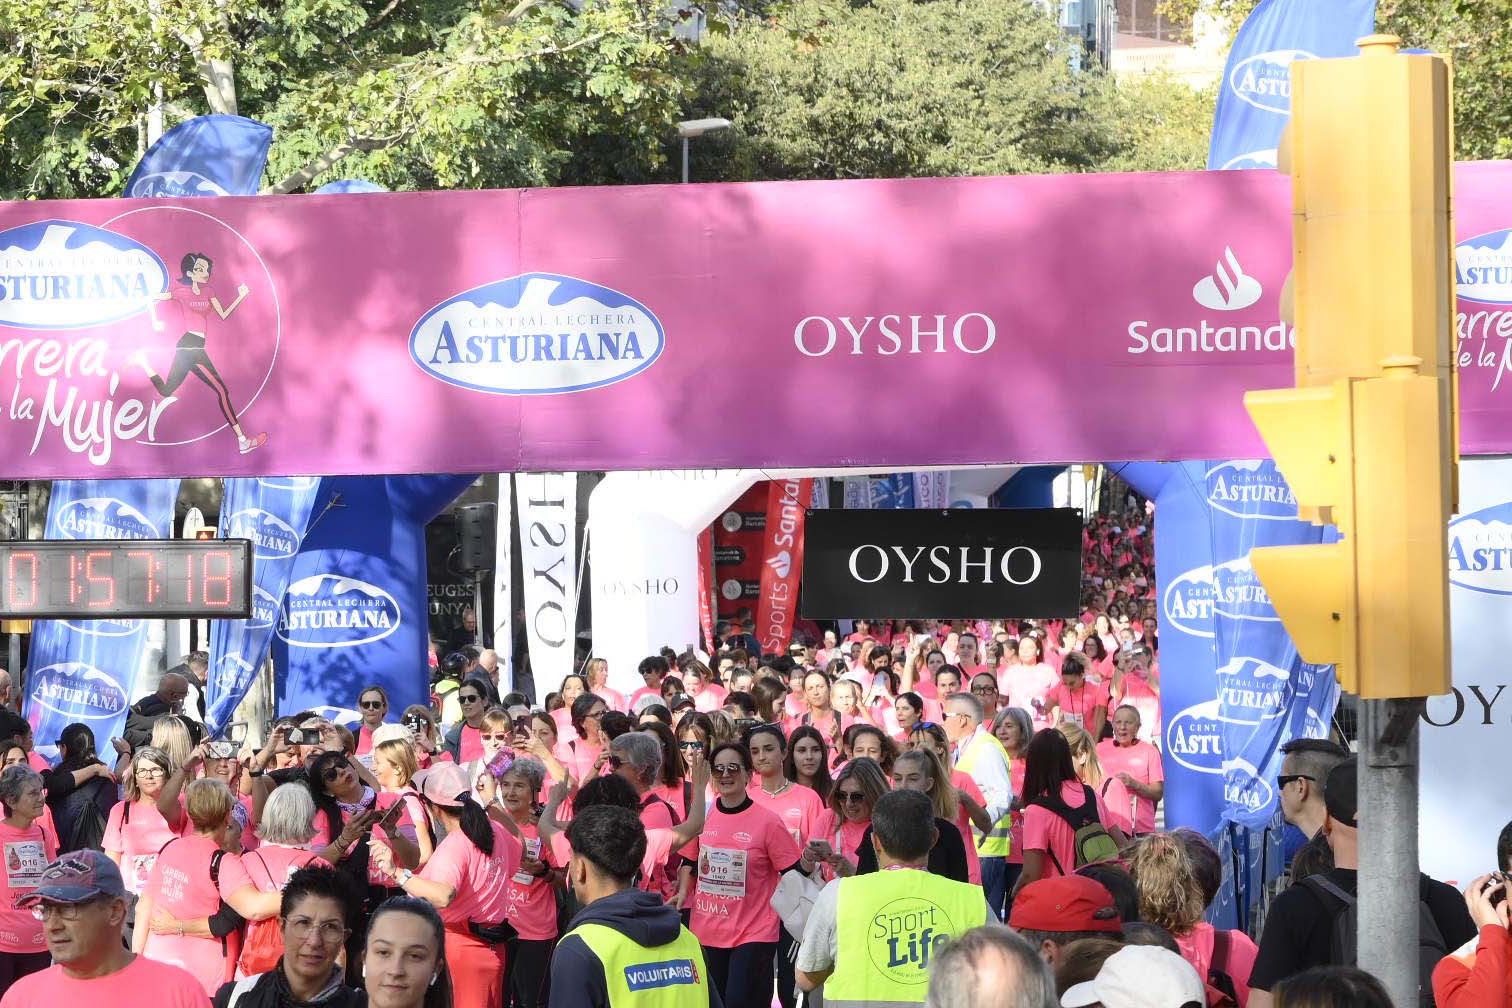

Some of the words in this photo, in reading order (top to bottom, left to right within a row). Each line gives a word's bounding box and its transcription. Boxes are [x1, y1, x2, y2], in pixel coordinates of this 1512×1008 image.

[429, 320, 645, 364] ASTURIANA
[793, 313, 997, 357] OYSHO
[9, 380, 34, 420] la
[29, 373, 179, 466] Mujer
[848, 544, 1042, 585] OYSHO
[278, 605, 392, 631] ASTURIANA
[291, 599, 333, 609] CENTRAL
[337, 599, 387, 608] LECHERA
[711, 866, 728, 874] 016
[696, 899, 728, 915] SUMA
[874, 906, 937, 939] Sport
[627, 966, 692, 985] VOLUNTARIS
